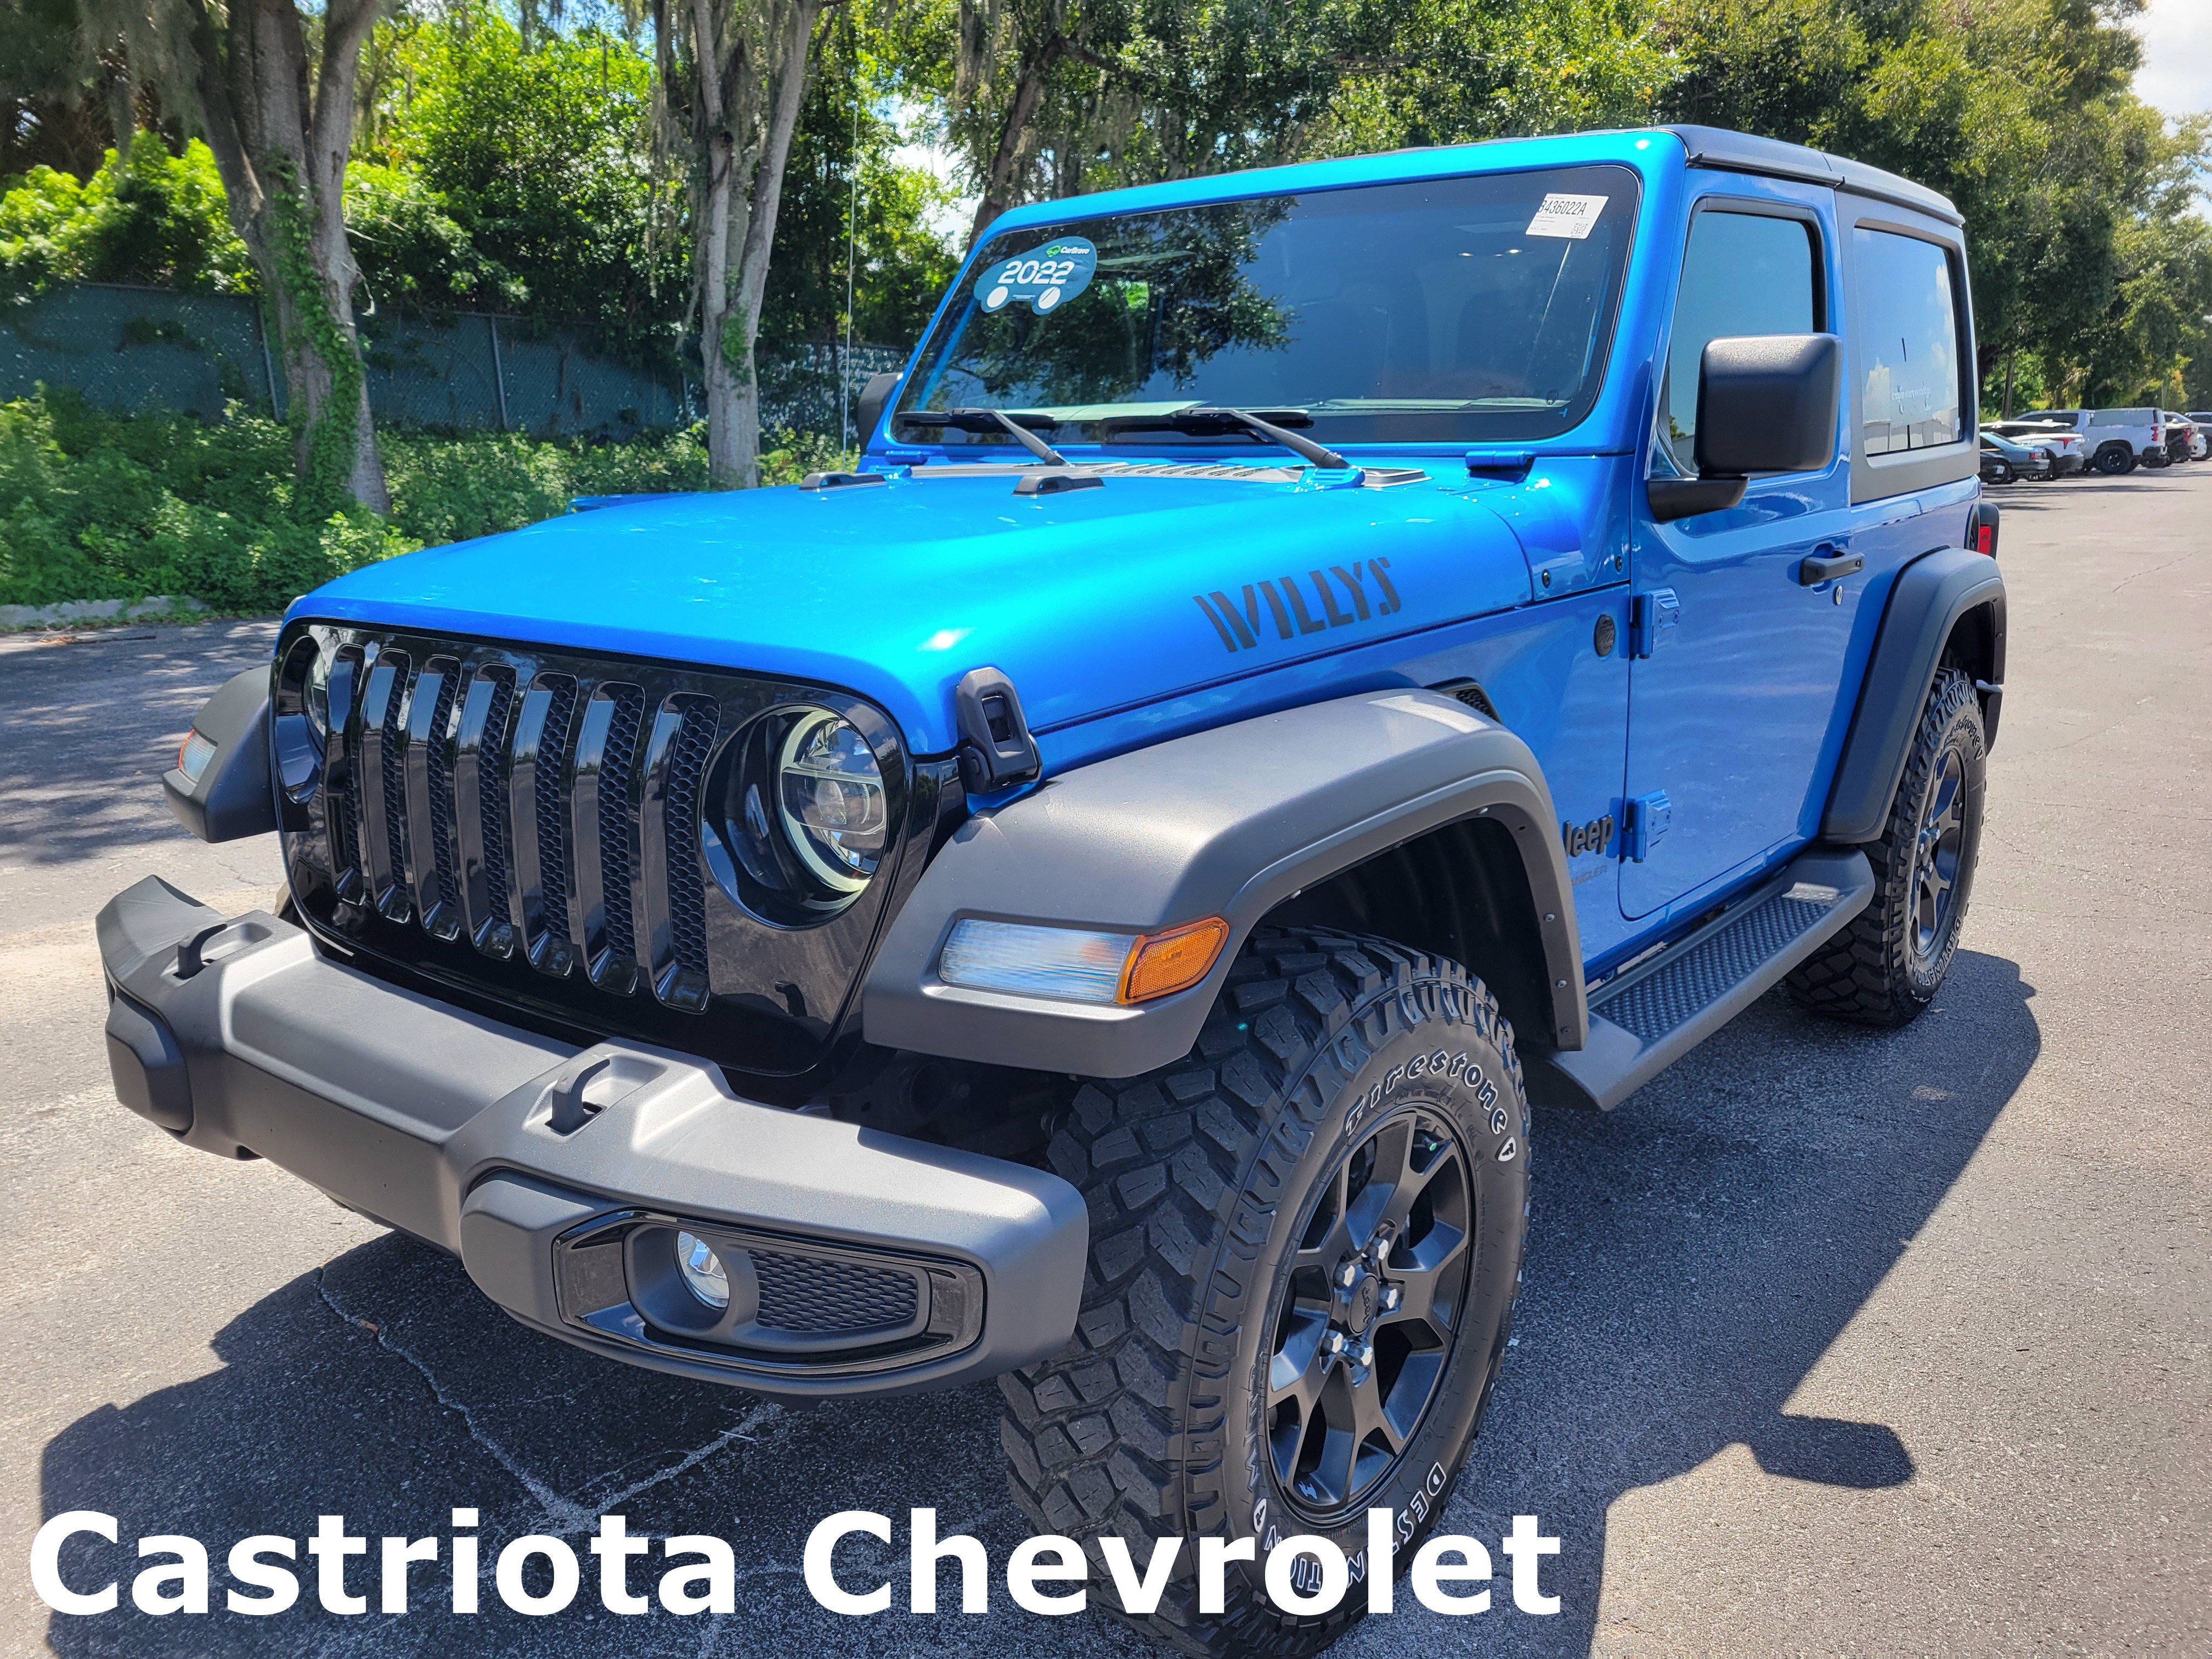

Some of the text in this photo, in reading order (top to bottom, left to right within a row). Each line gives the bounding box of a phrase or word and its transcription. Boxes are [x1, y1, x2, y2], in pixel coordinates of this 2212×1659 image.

[997, 260, 1075, 284] 2022
[1193, 556, 1401, 652] WILLYS
[1563, 814, 1615, 857] Jeep
[1344, 1048, 1509, 1138] Firestone
[1263, 1461, 1447, 1593] DESNTIN
